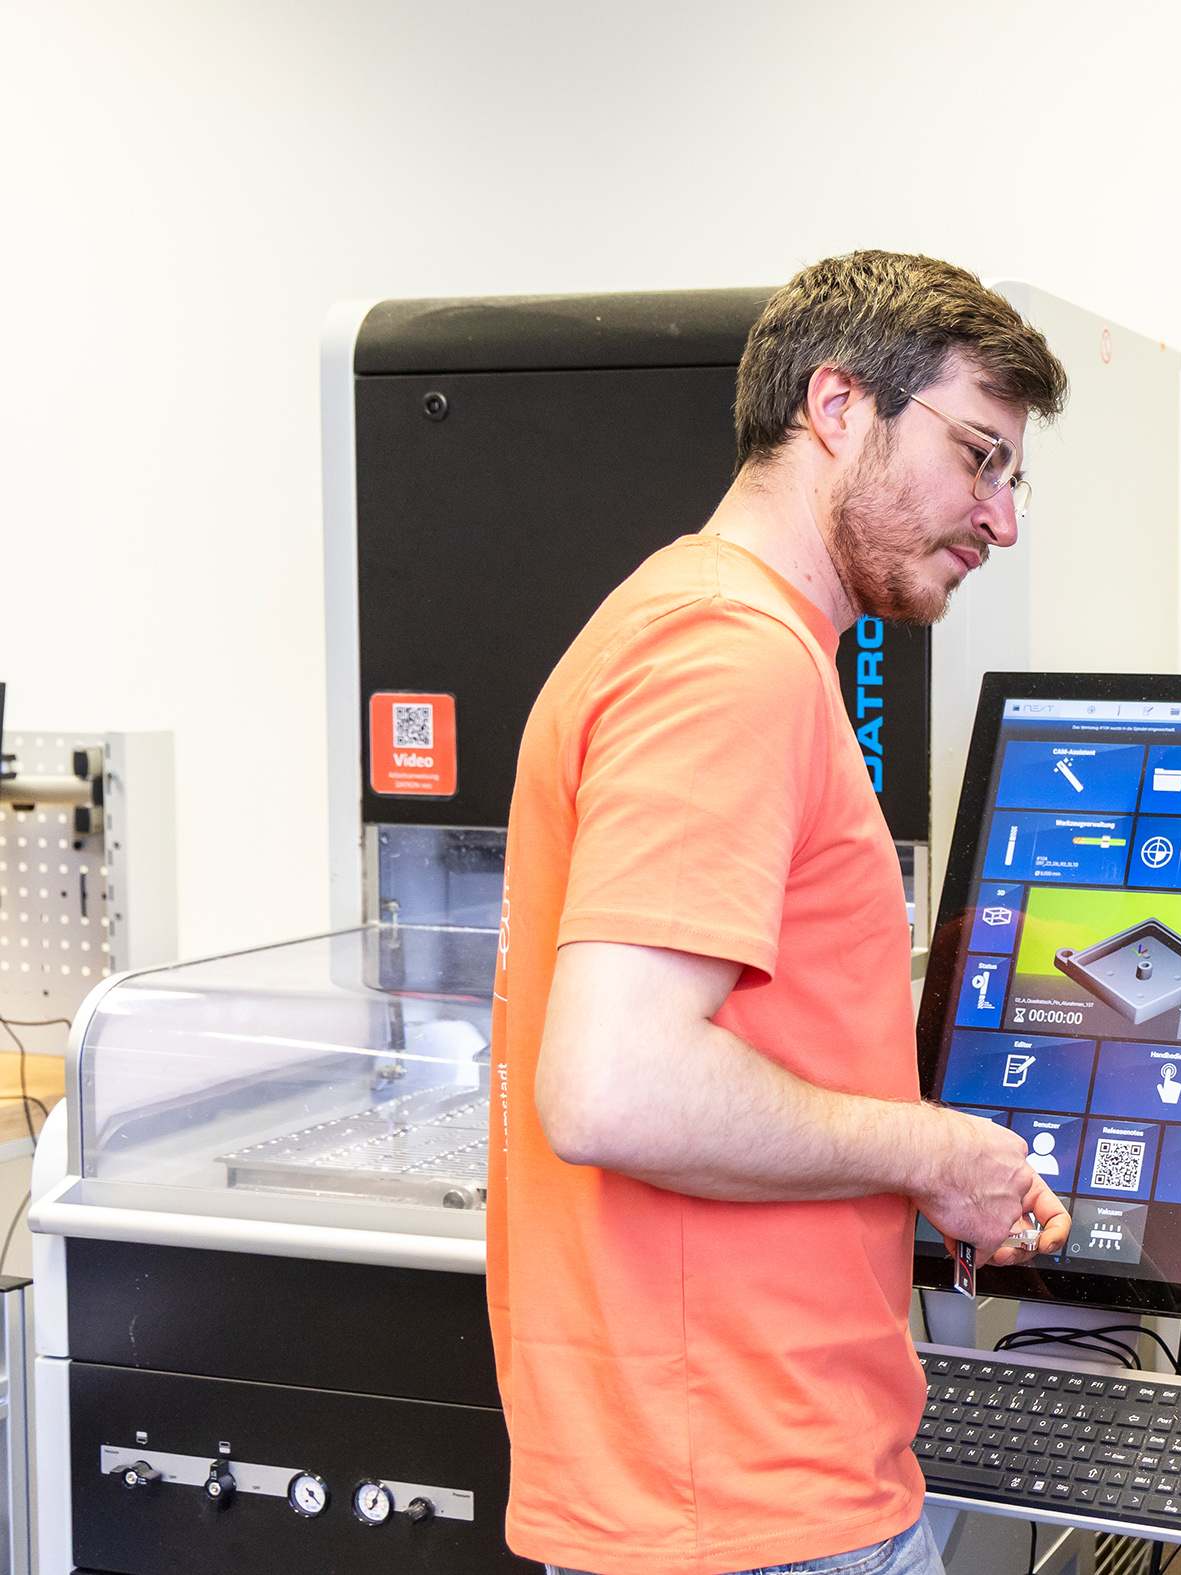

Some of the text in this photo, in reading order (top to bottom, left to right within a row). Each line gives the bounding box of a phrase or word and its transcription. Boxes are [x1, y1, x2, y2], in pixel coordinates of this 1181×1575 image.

[1053, 748, 1096, 756] CAM-Assistent
[393, 752, 435, 768] Video
[1055, 819, 1116, 829] Werkzeugverwaltung
[978, 962, 998, 970] Status
[1028, 1009, 1083, 1025] 00:00:00
[1013, 1041, 1033, 1049] Editor
[498, 1063, 508, 1152] mstadt
[1033, 1121, 1061, 1130] Benutzer
[1102, 1127, 1144, 1137] Releasenotes
[1097, 1207, 1123, 1217] Vakuum
